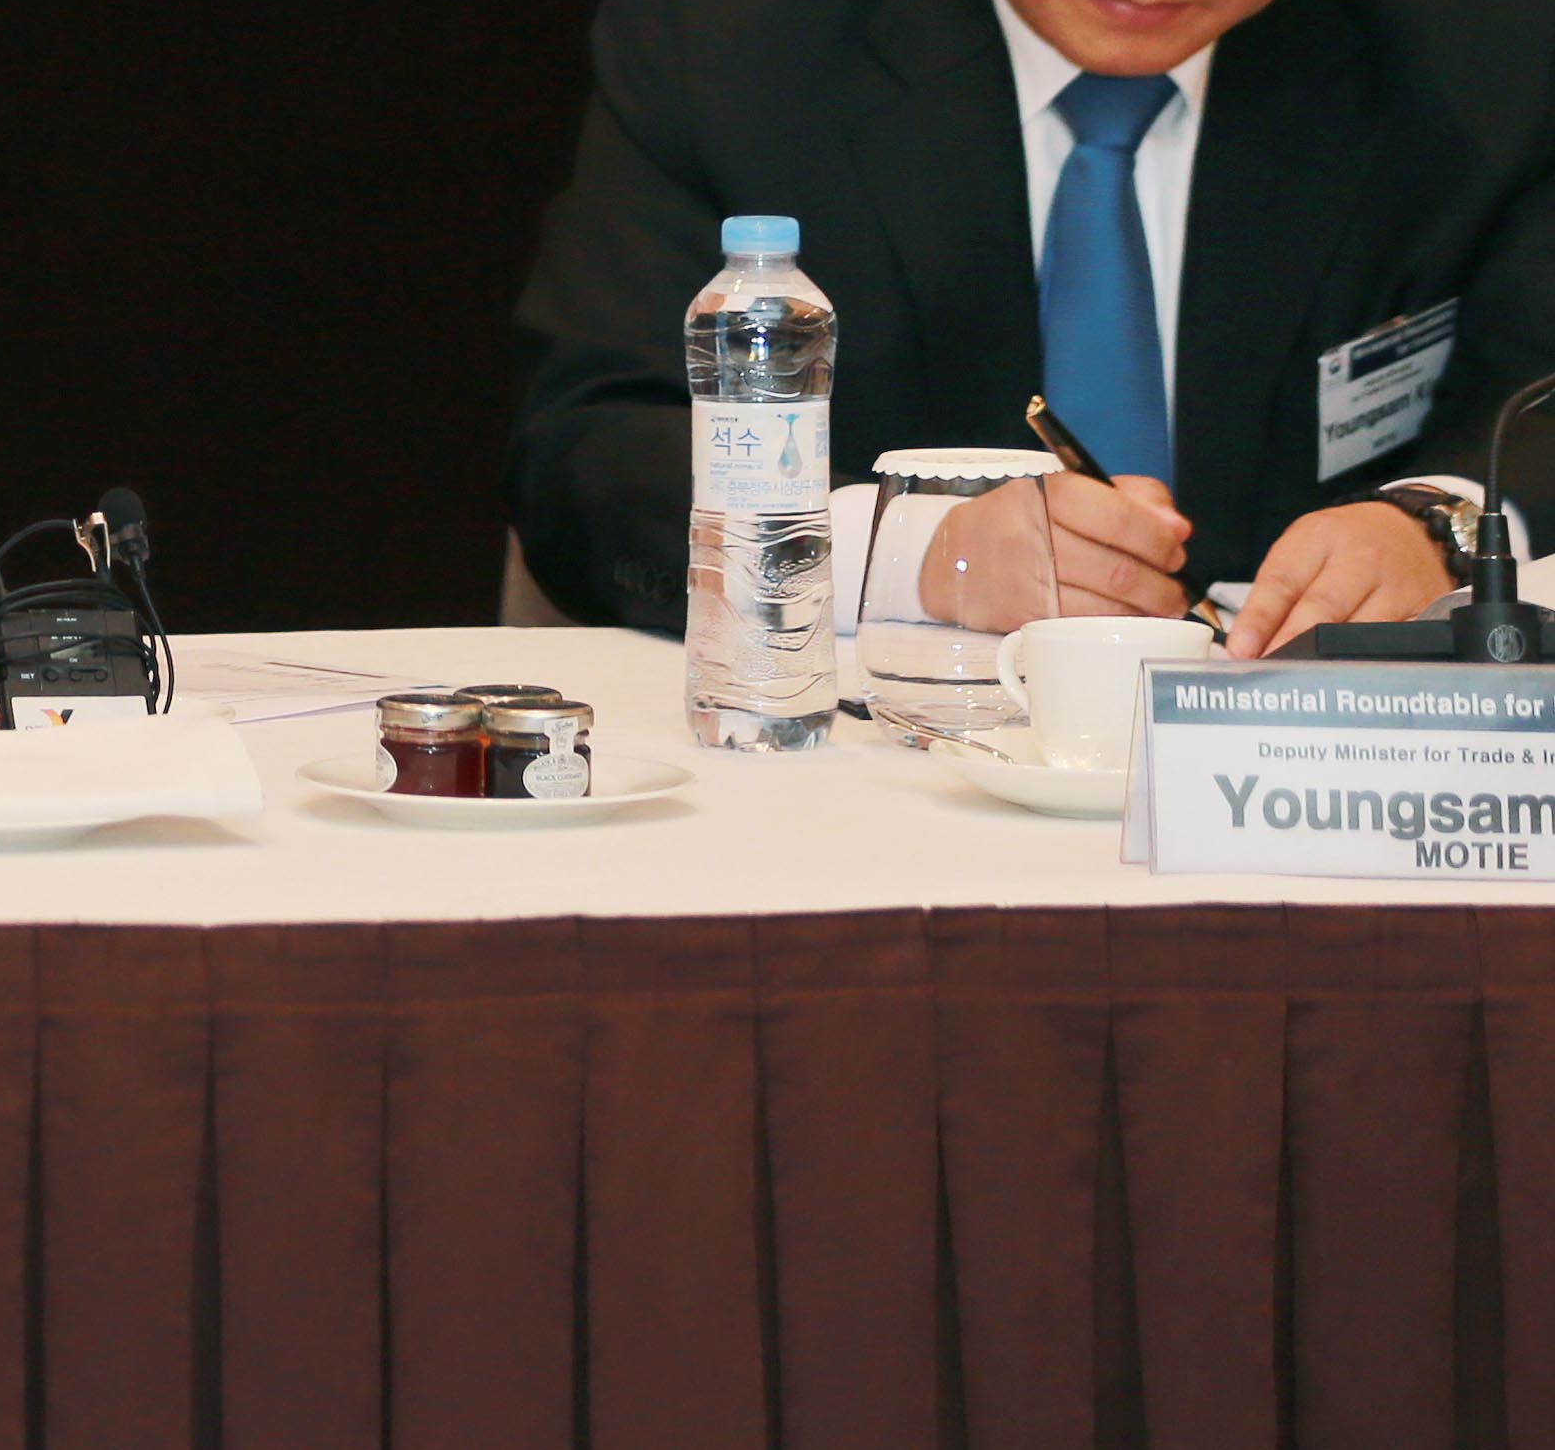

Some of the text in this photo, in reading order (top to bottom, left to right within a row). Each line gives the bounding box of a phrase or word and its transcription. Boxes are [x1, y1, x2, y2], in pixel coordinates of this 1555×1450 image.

[710, 427, 763, 457] 석수
[1175, 684, 1545, 718] Ministerial Roundtable for
[1258, 741, 1328, 762] Deputy
[1335, 744, 1417, 763] Minister
[1424, 746, 1451, 763] for
[1457, 747, 1515, 765] Trade
[1522, 749, 1536, 765] &
[1415, 839, 1530, 871] MOTIE
